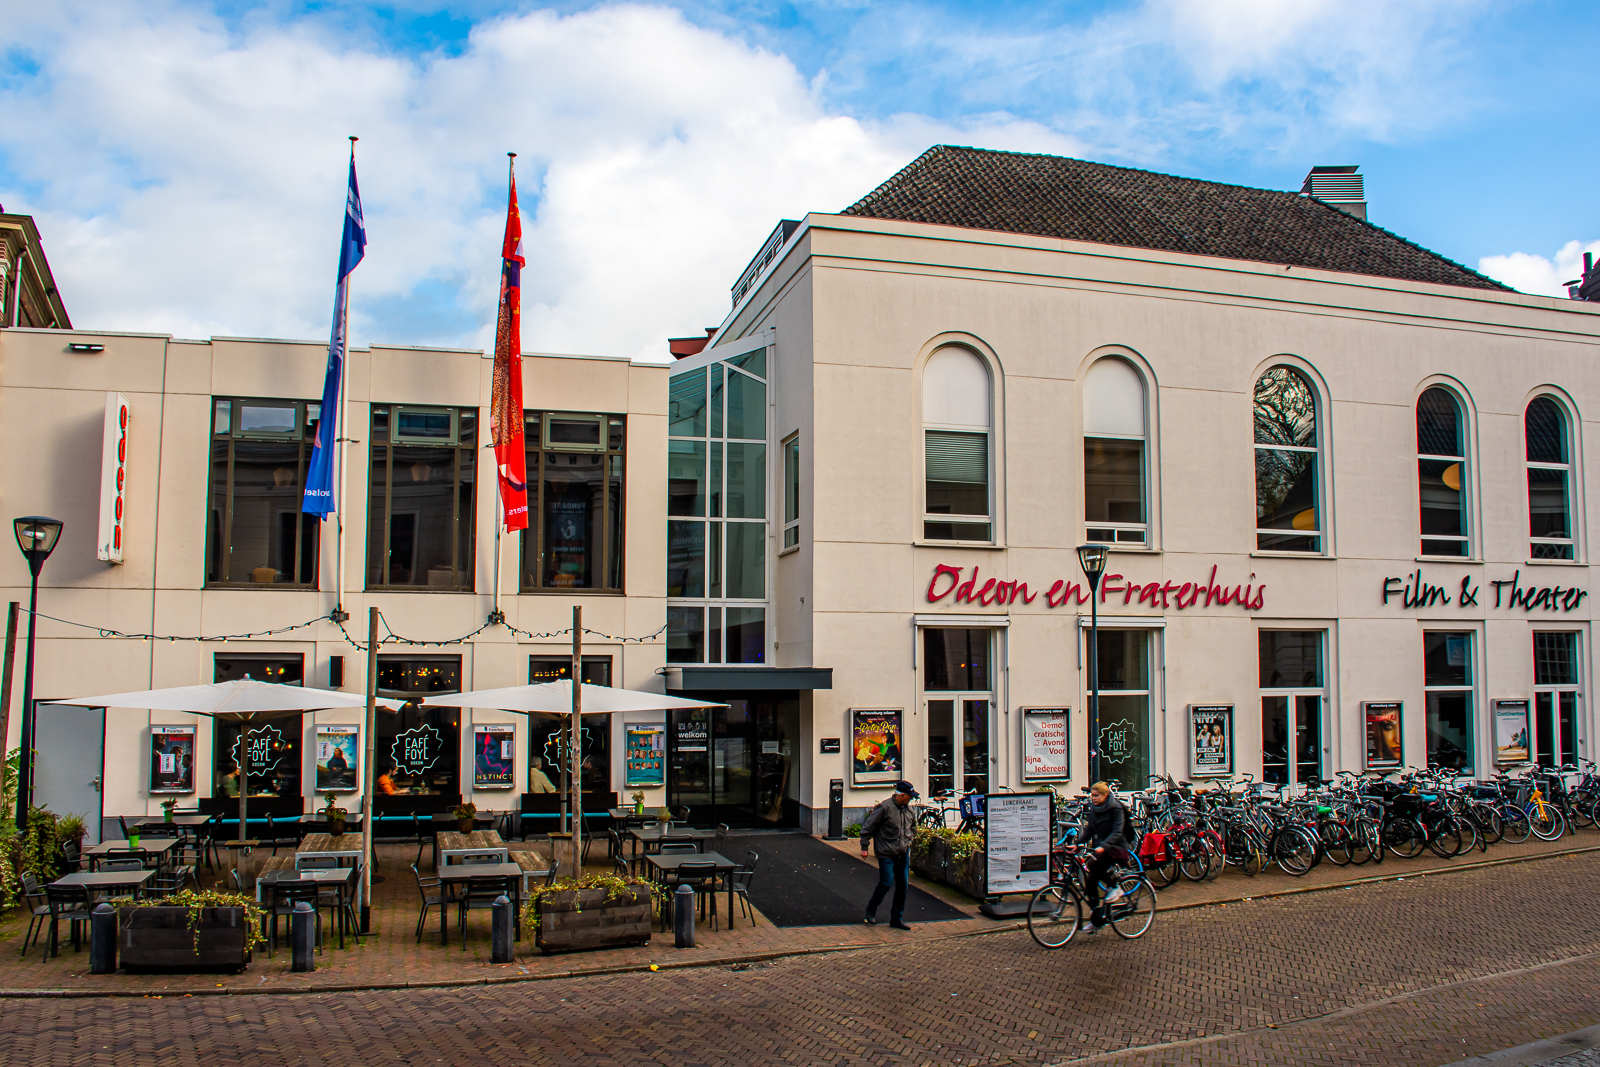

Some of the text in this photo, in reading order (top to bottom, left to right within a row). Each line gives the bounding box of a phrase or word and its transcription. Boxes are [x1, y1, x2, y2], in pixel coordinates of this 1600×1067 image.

[928, 563, 1266, 609] Odeon en Fraterhuis
[1383, 568, 1588, 611] Film & Theater
[1041, 721, 1065, 729] Demo-
[677, 731, 707, 739] welkom
[1034, 730, 1065, 738] cratische
[404, 733, 429, 749] CAFÉ
[1034, 765, 1065, 773] Iedereen
